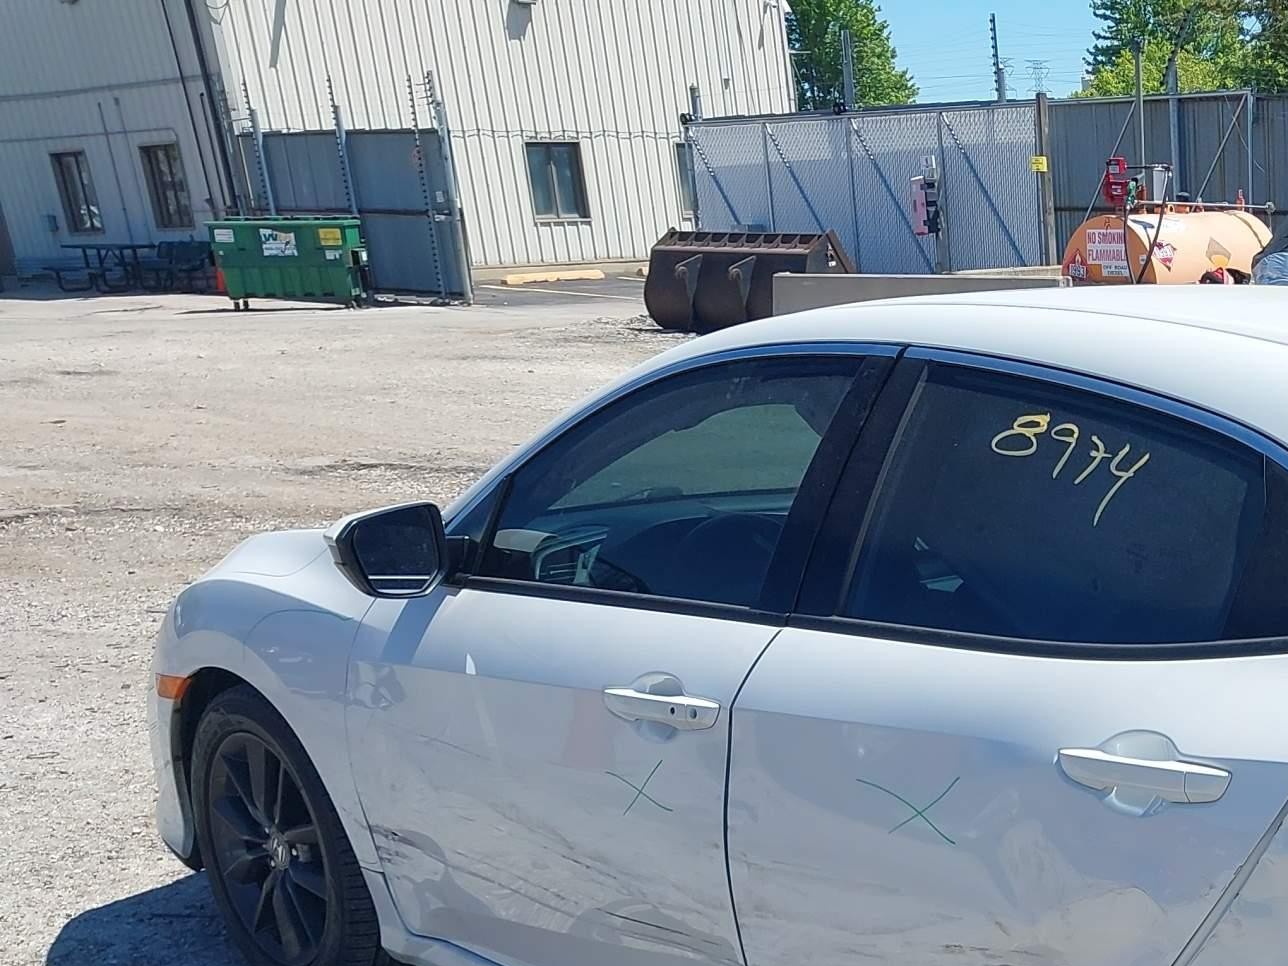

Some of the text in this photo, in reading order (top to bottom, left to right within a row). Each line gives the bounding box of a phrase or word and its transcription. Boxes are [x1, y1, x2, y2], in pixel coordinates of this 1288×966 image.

[1087, 231, 1126, 244] NO SMOKIN
[1087, 249, 1128, 261] FLAMMABL
[991, 412, 1150, 527] 8974
